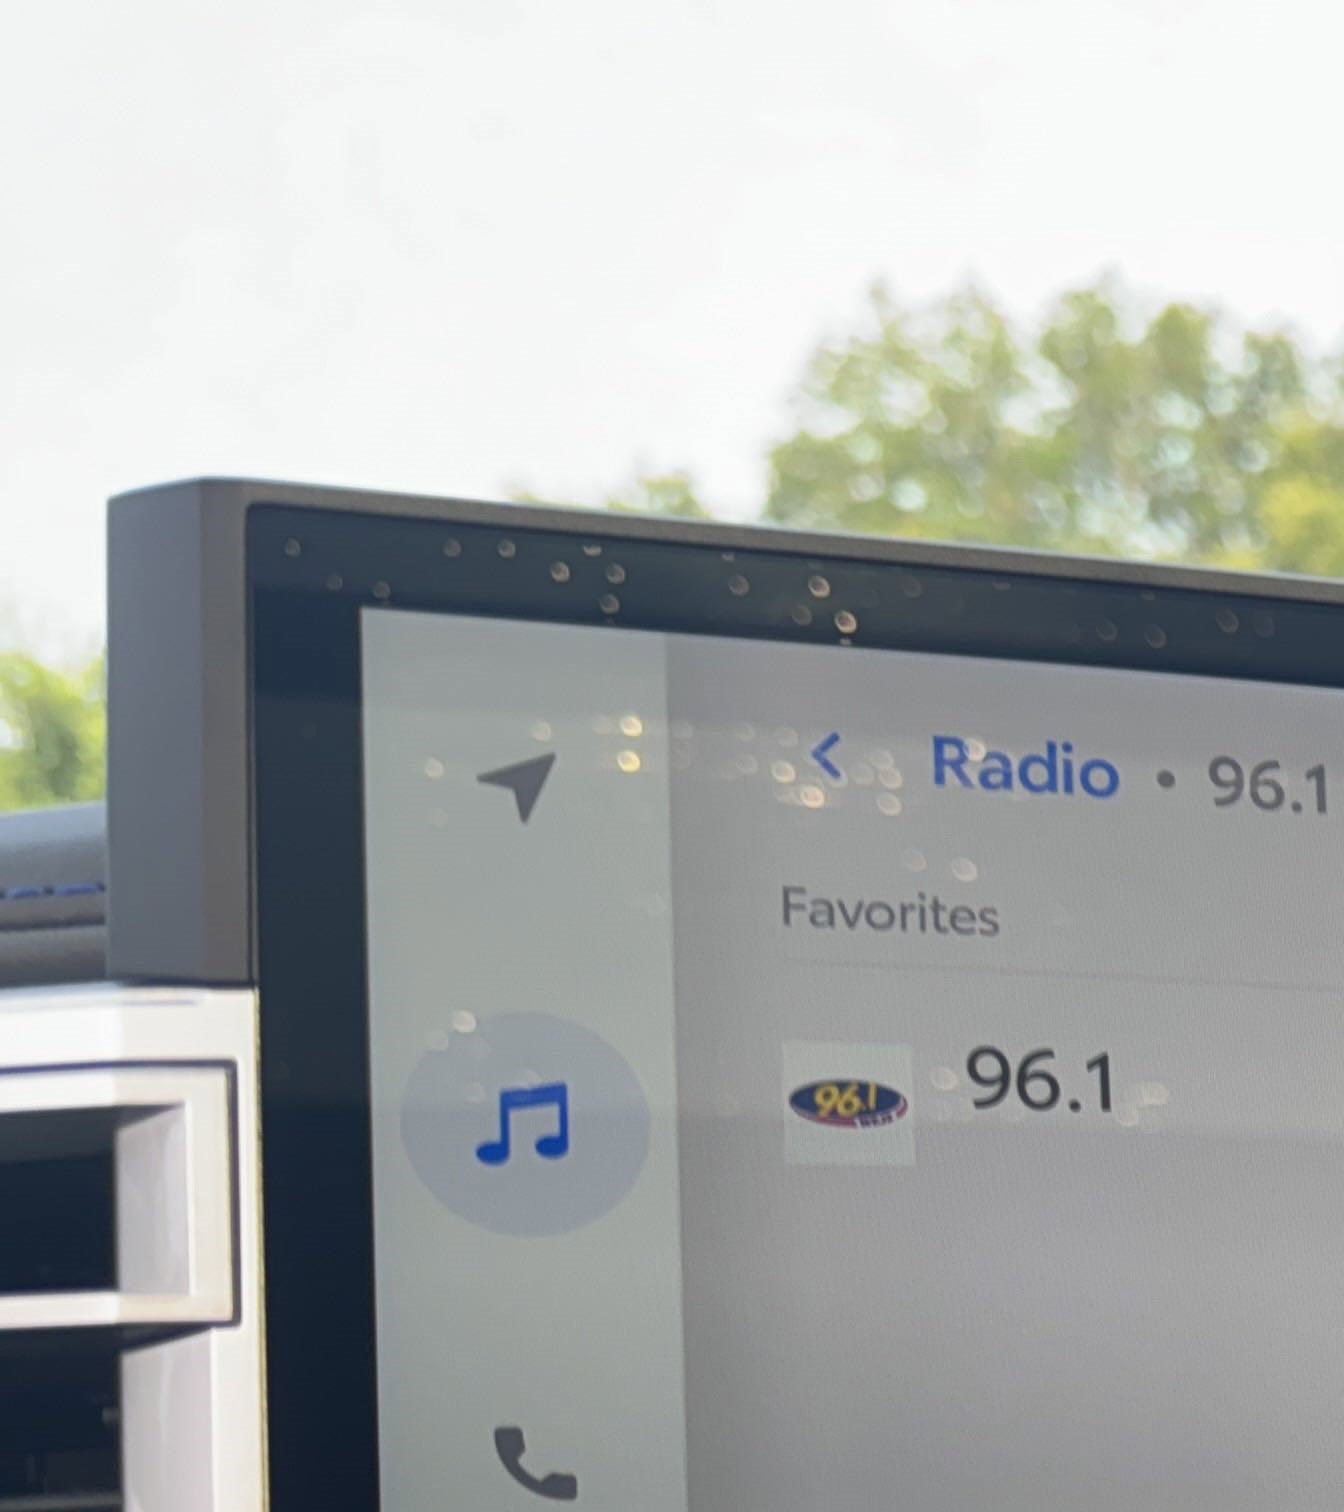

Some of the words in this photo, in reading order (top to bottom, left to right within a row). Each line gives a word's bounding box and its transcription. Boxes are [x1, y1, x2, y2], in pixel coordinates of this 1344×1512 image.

[932, 735, 1120, 800] Radio
[1207, 756, 1330, 815] 96.1
[780, 886, 1001, 938] Favorites
[815, 1082, 877, 1118] 96.1
[965, 1045, 1115, 1113] 96.1
